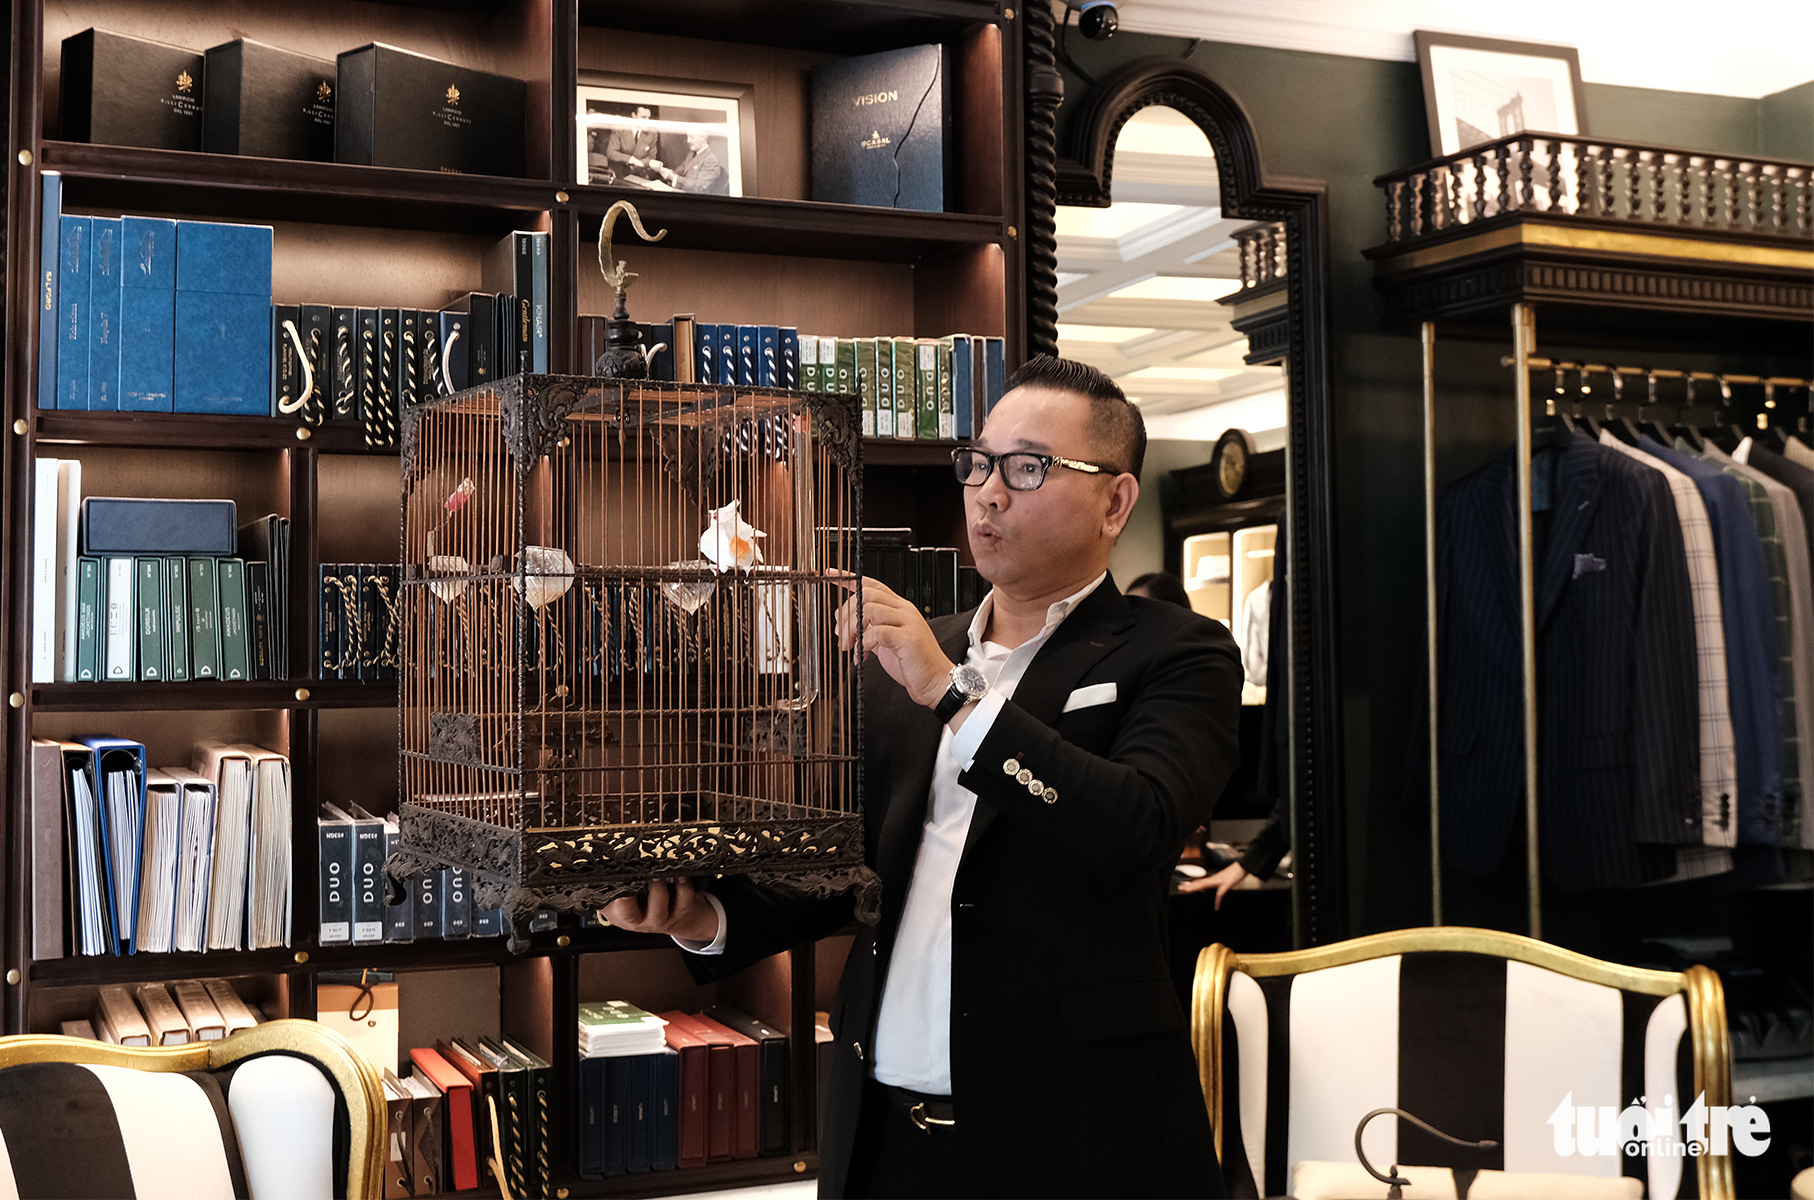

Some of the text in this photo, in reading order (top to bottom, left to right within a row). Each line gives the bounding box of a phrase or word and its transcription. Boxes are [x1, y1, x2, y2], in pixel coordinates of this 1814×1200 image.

[853, 90, 898, 106] VISION
[45, 271, 53, 311] SALFORD
[521, 298, 531, 343] Gentleman
[881, 367, 890, 407] DUO
[896, 369, 905, 409] DUO
[926, 371, 935, 411] DUO
[329, 862, 340, 903] DUO
[363, 862, 374, 903] DUO
[422, 878, 433, 905] UO
